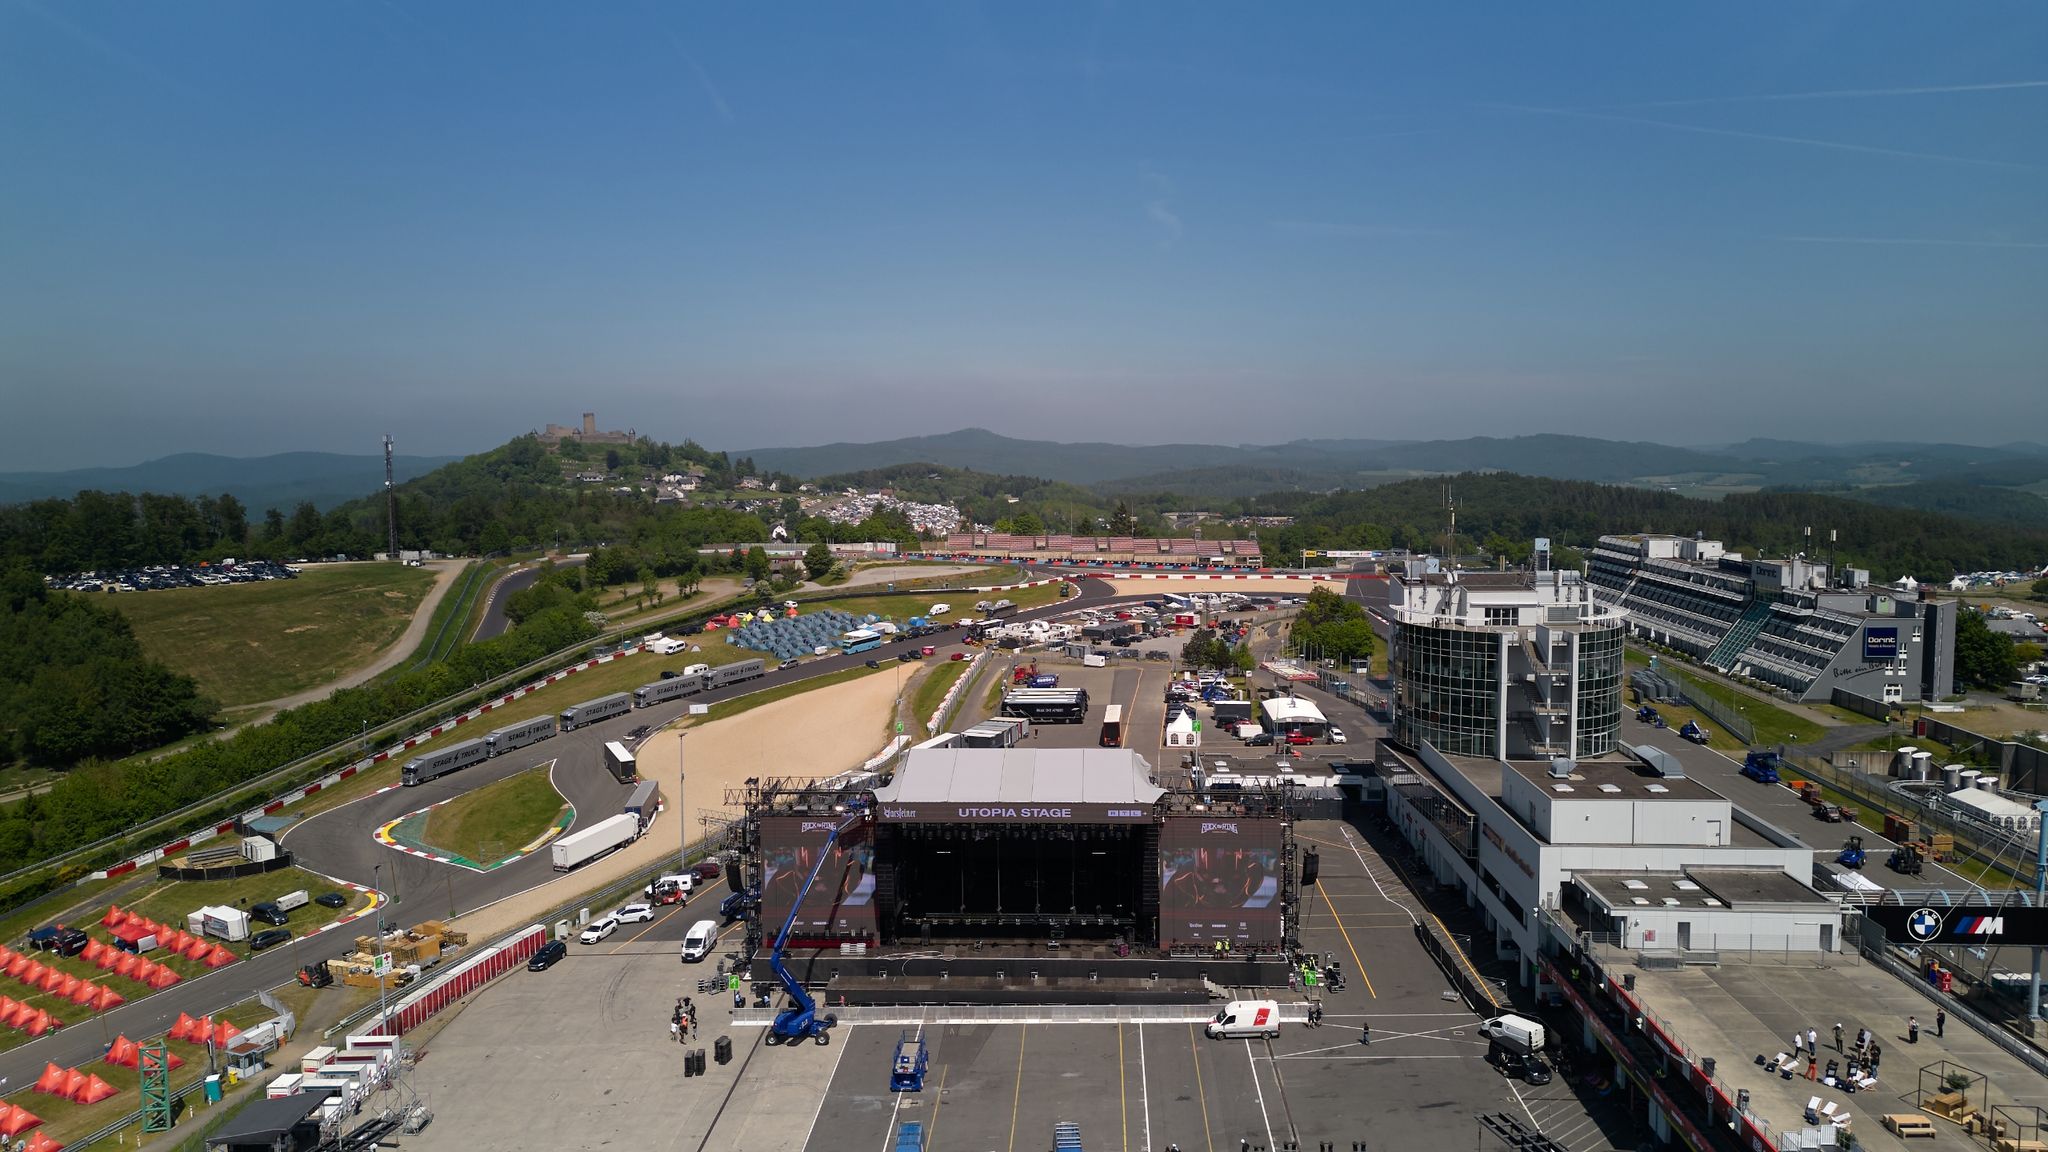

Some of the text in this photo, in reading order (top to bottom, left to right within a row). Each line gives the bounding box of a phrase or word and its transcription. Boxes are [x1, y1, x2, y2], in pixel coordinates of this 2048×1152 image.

[1756, 565, 1777, 578] Dorint
[723, 664, 760, 678] STAGE TRUCK
[1833, 667, 1852, 678] Bitte
[656, 680, 696, 695] STAGE TRUCK
[585, 700, 626, 716] STAGE TRUCK
[508, 722, 551, 741] STAGE TRUCK
[432, 748, 480, 769] STAGE TRUCK
[958, 808, 1072, 818] UTOPIA STAGE
[801, 822, 817, 833] ROCK
[1201, 823, 1216, 834] ROCK
[1222, 823, 1239, 834] RING
[1912, 910, 1938, 919] BMW
[1974, 916, 2003, 934] M
